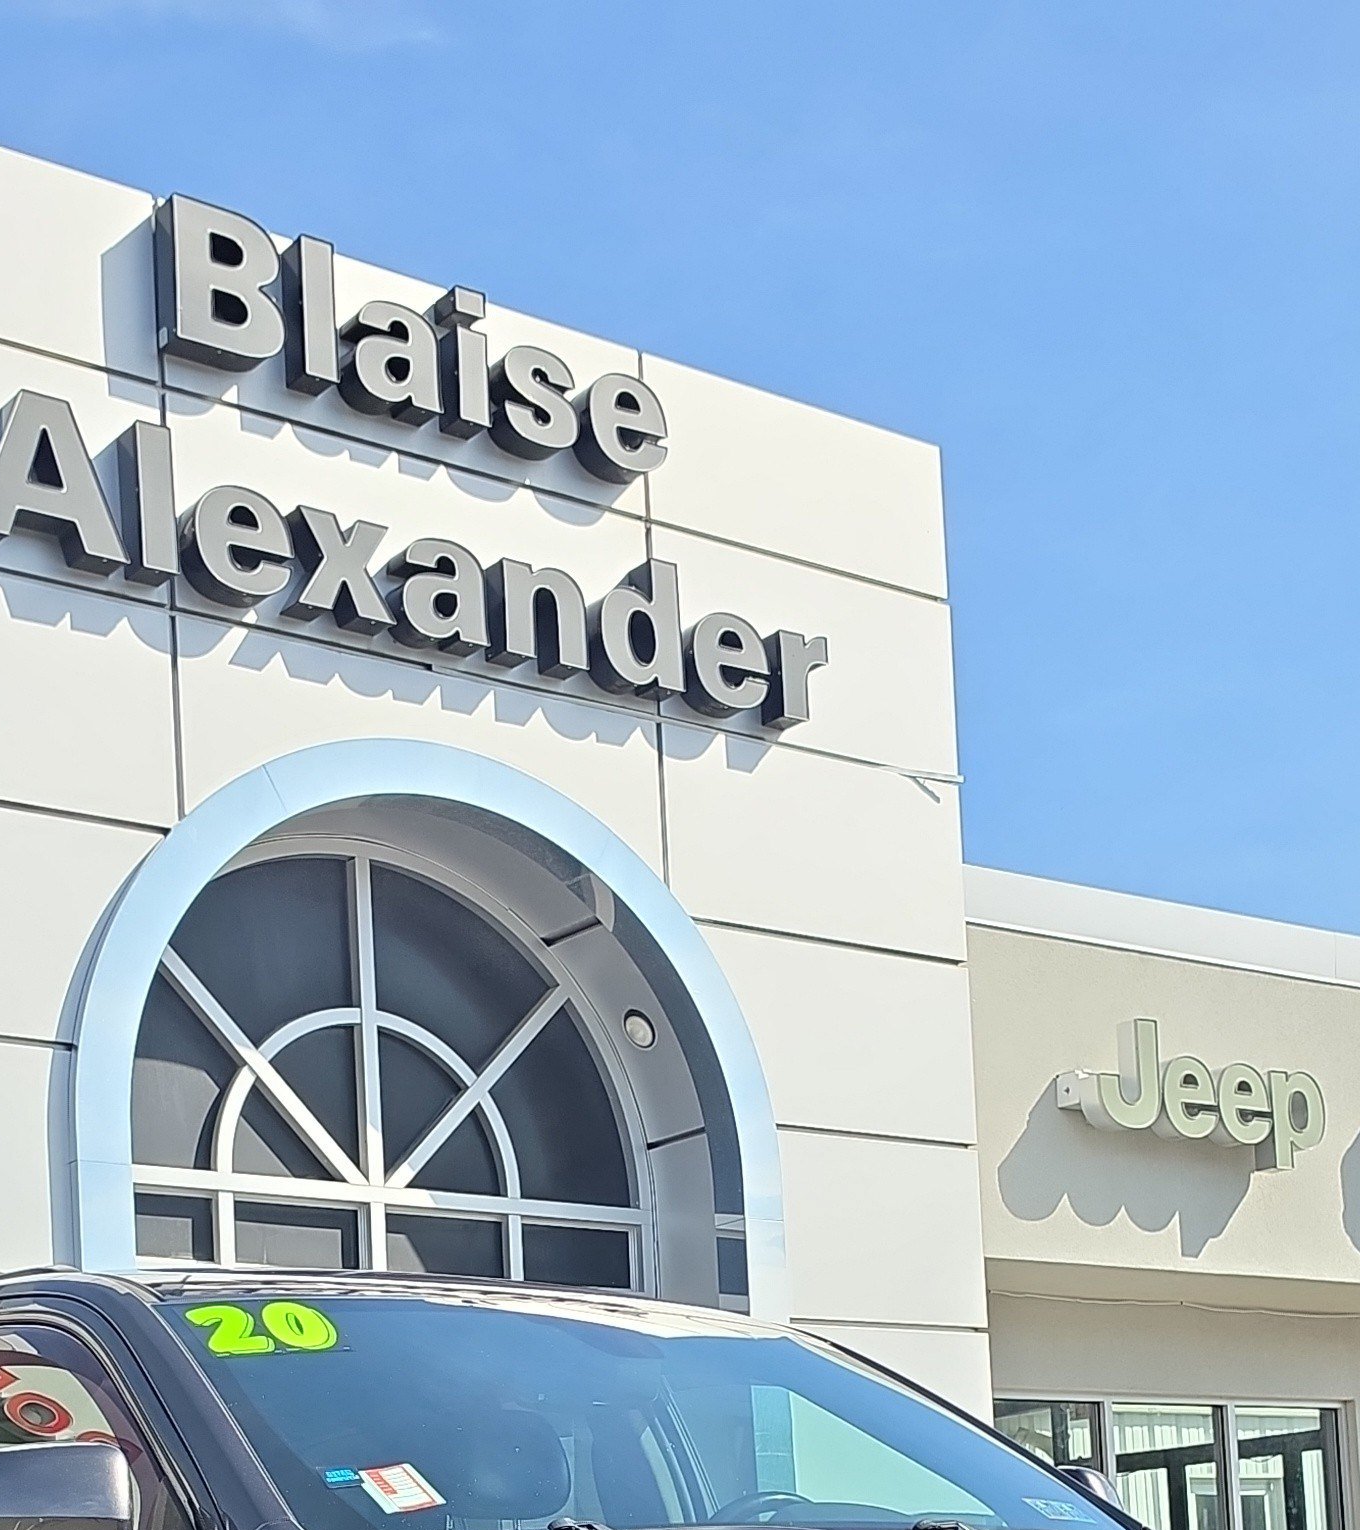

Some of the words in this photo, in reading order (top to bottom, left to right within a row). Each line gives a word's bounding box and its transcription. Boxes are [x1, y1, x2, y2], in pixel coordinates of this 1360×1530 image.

[160, 193, 668, 480] Blaise
[1092, 1018, 1326, 1170] Jeep
[184, 1301, 338, 1354] 20
